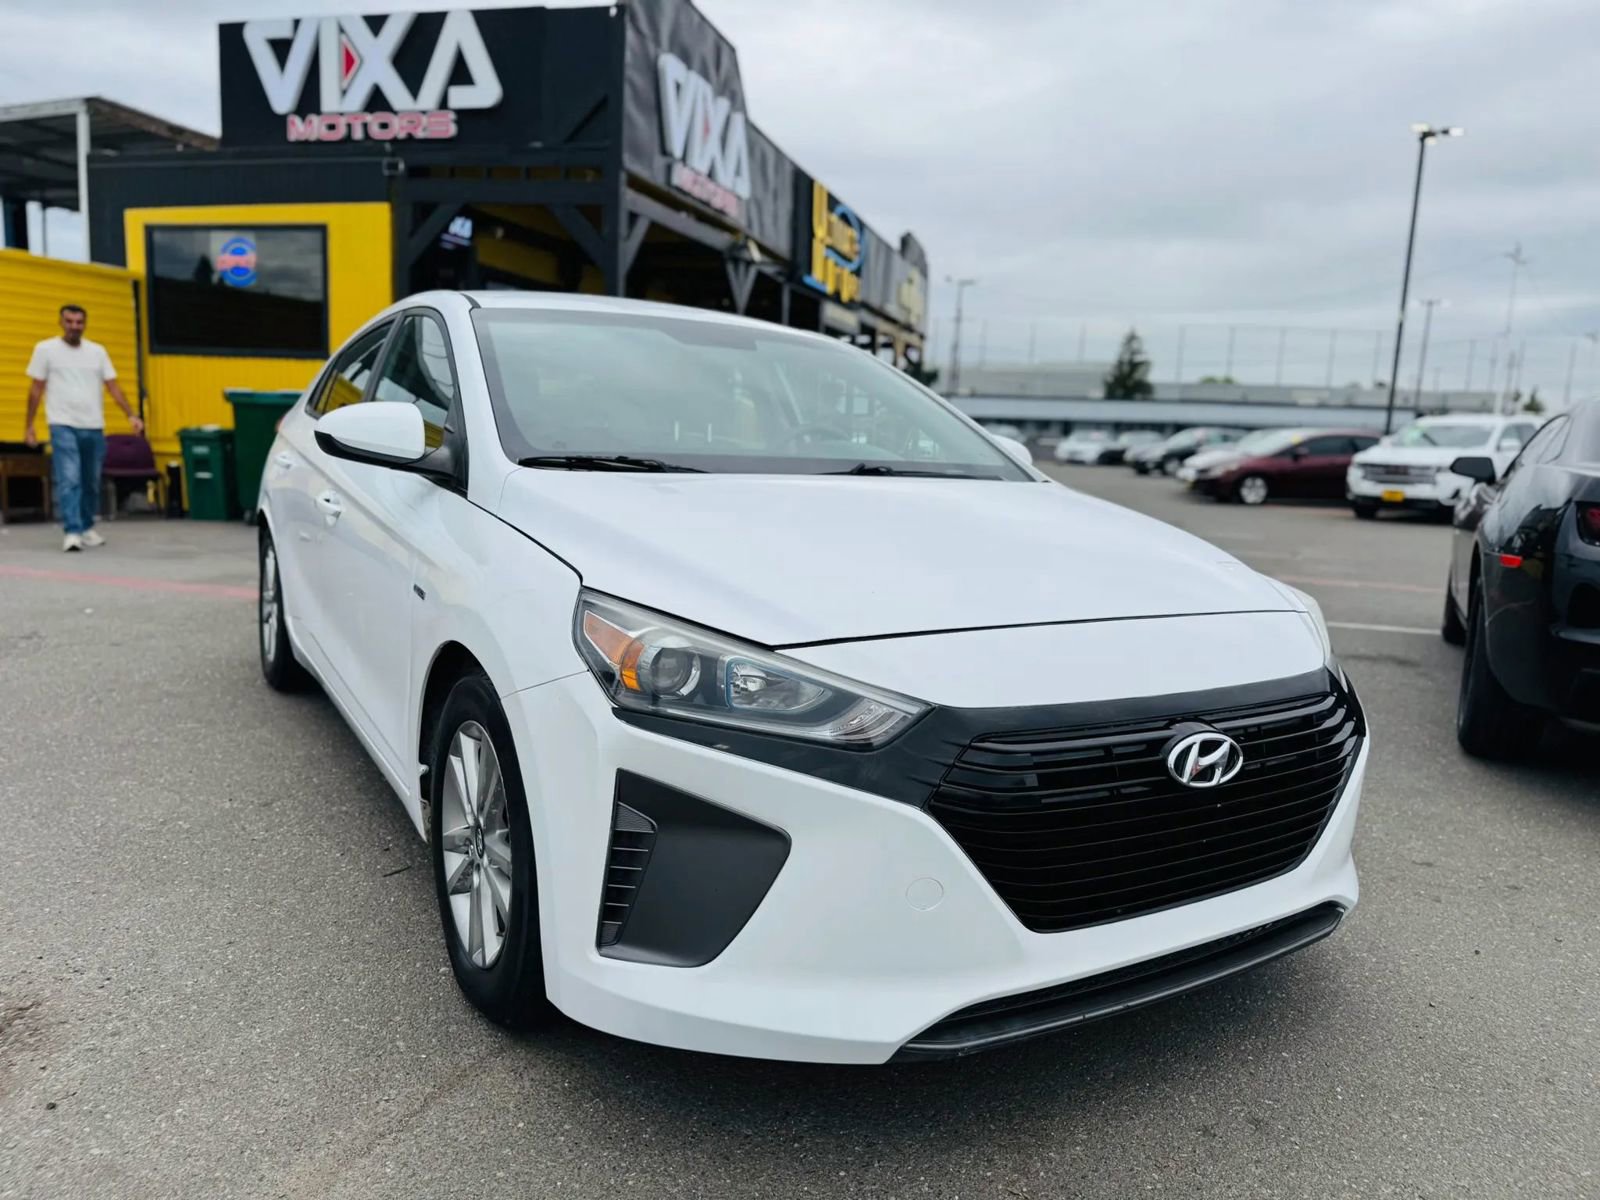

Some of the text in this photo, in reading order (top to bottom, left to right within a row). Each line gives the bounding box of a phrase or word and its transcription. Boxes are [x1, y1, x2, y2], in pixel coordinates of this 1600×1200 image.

[243, 10, 503, 115] VIXA
[286, 110, 458, 141] MOTORS
[657, 52, 751, 200] VIXA
